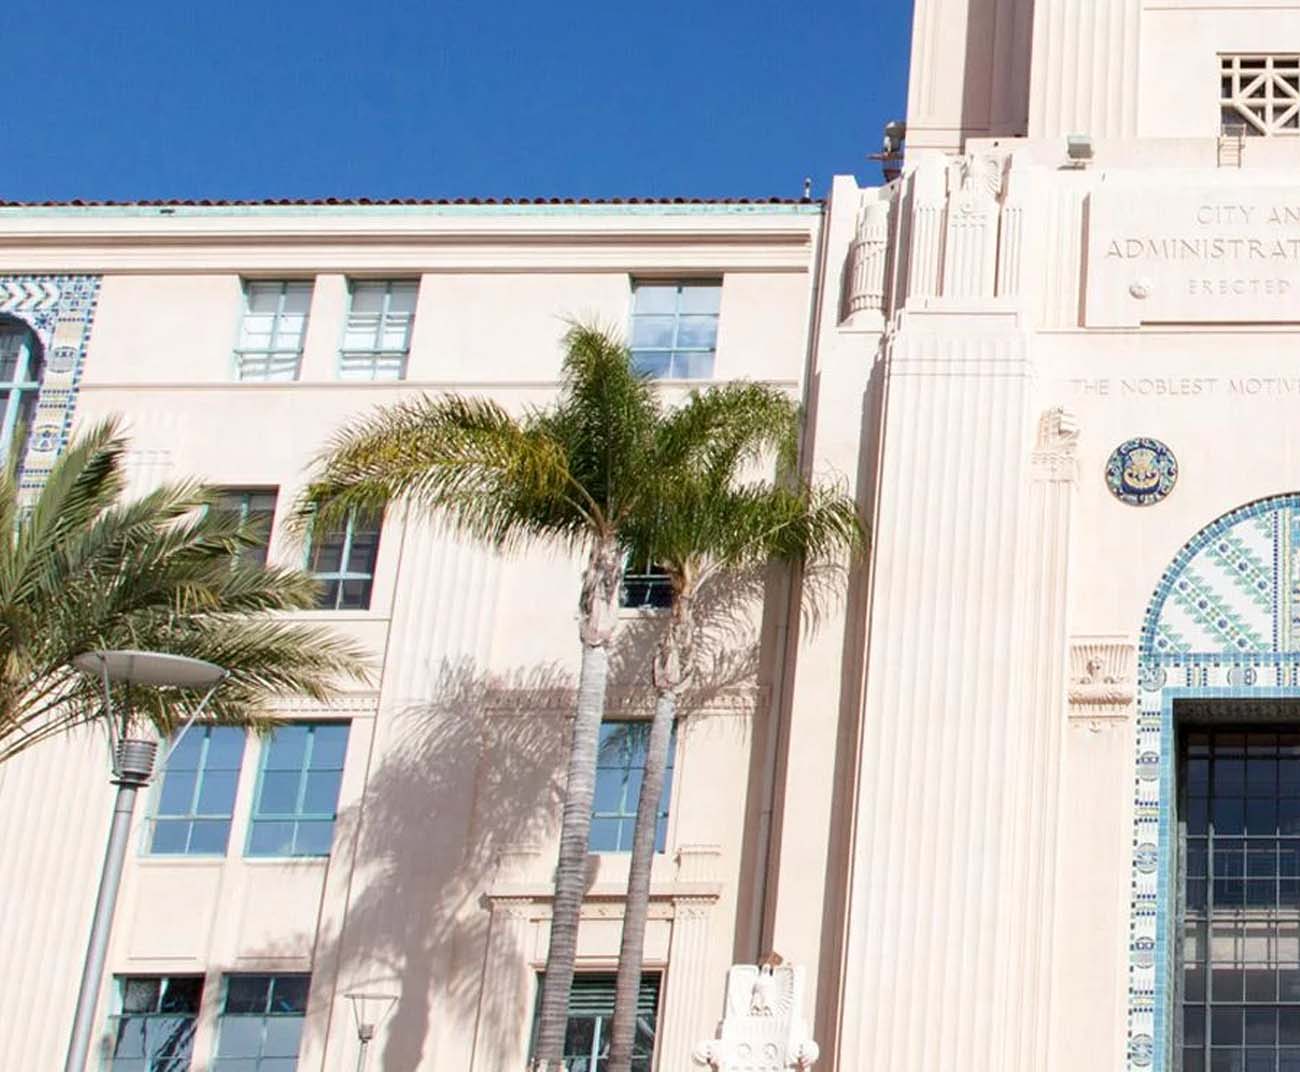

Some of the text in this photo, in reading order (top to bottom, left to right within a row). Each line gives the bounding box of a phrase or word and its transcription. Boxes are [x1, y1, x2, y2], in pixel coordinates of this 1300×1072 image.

[1196, 205, 1256, 225] CITY
[1188, 278, 1292, 296] ERECTED
[1067, 378, 1110, 396] THE
[1119, 378, 1219, 396] NOBLEST
